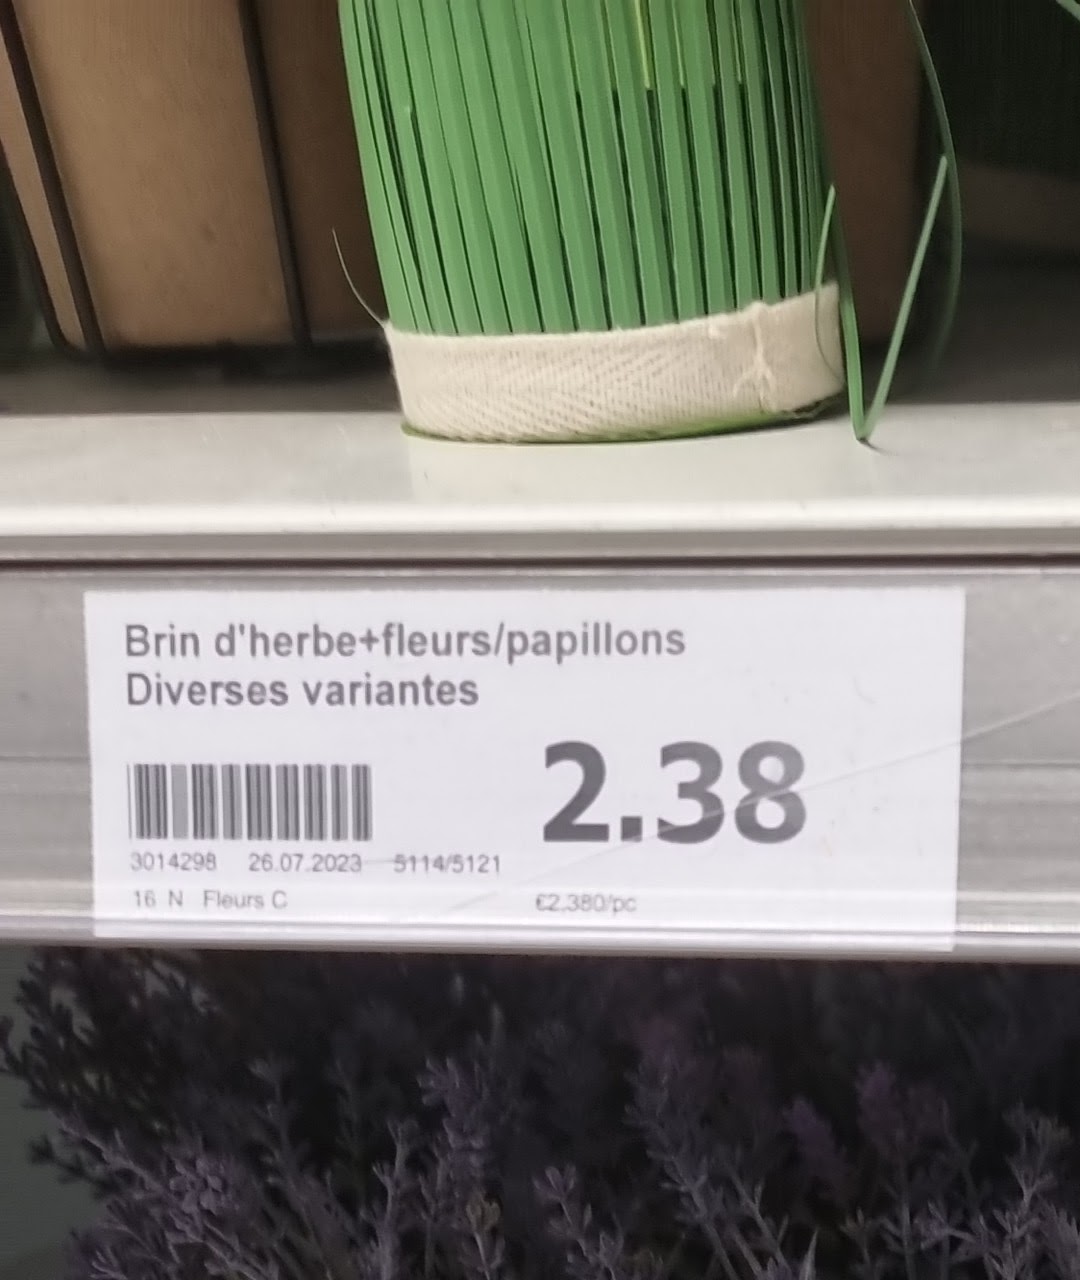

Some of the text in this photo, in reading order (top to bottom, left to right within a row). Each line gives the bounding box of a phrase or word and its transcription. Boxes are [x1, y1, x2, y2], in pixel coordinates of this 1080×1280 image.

[126, 622, 686, 666] Brin d'herbe+fleurs/papillons
[127, 672, 479, 706] Diverses variantes
[543, 741, 806, 844] 2.38
[131, 851, 500, 874] 3014298 26.07.2023 5114/5121
[134, 889, 288, 909] 16 N Fleurs C
